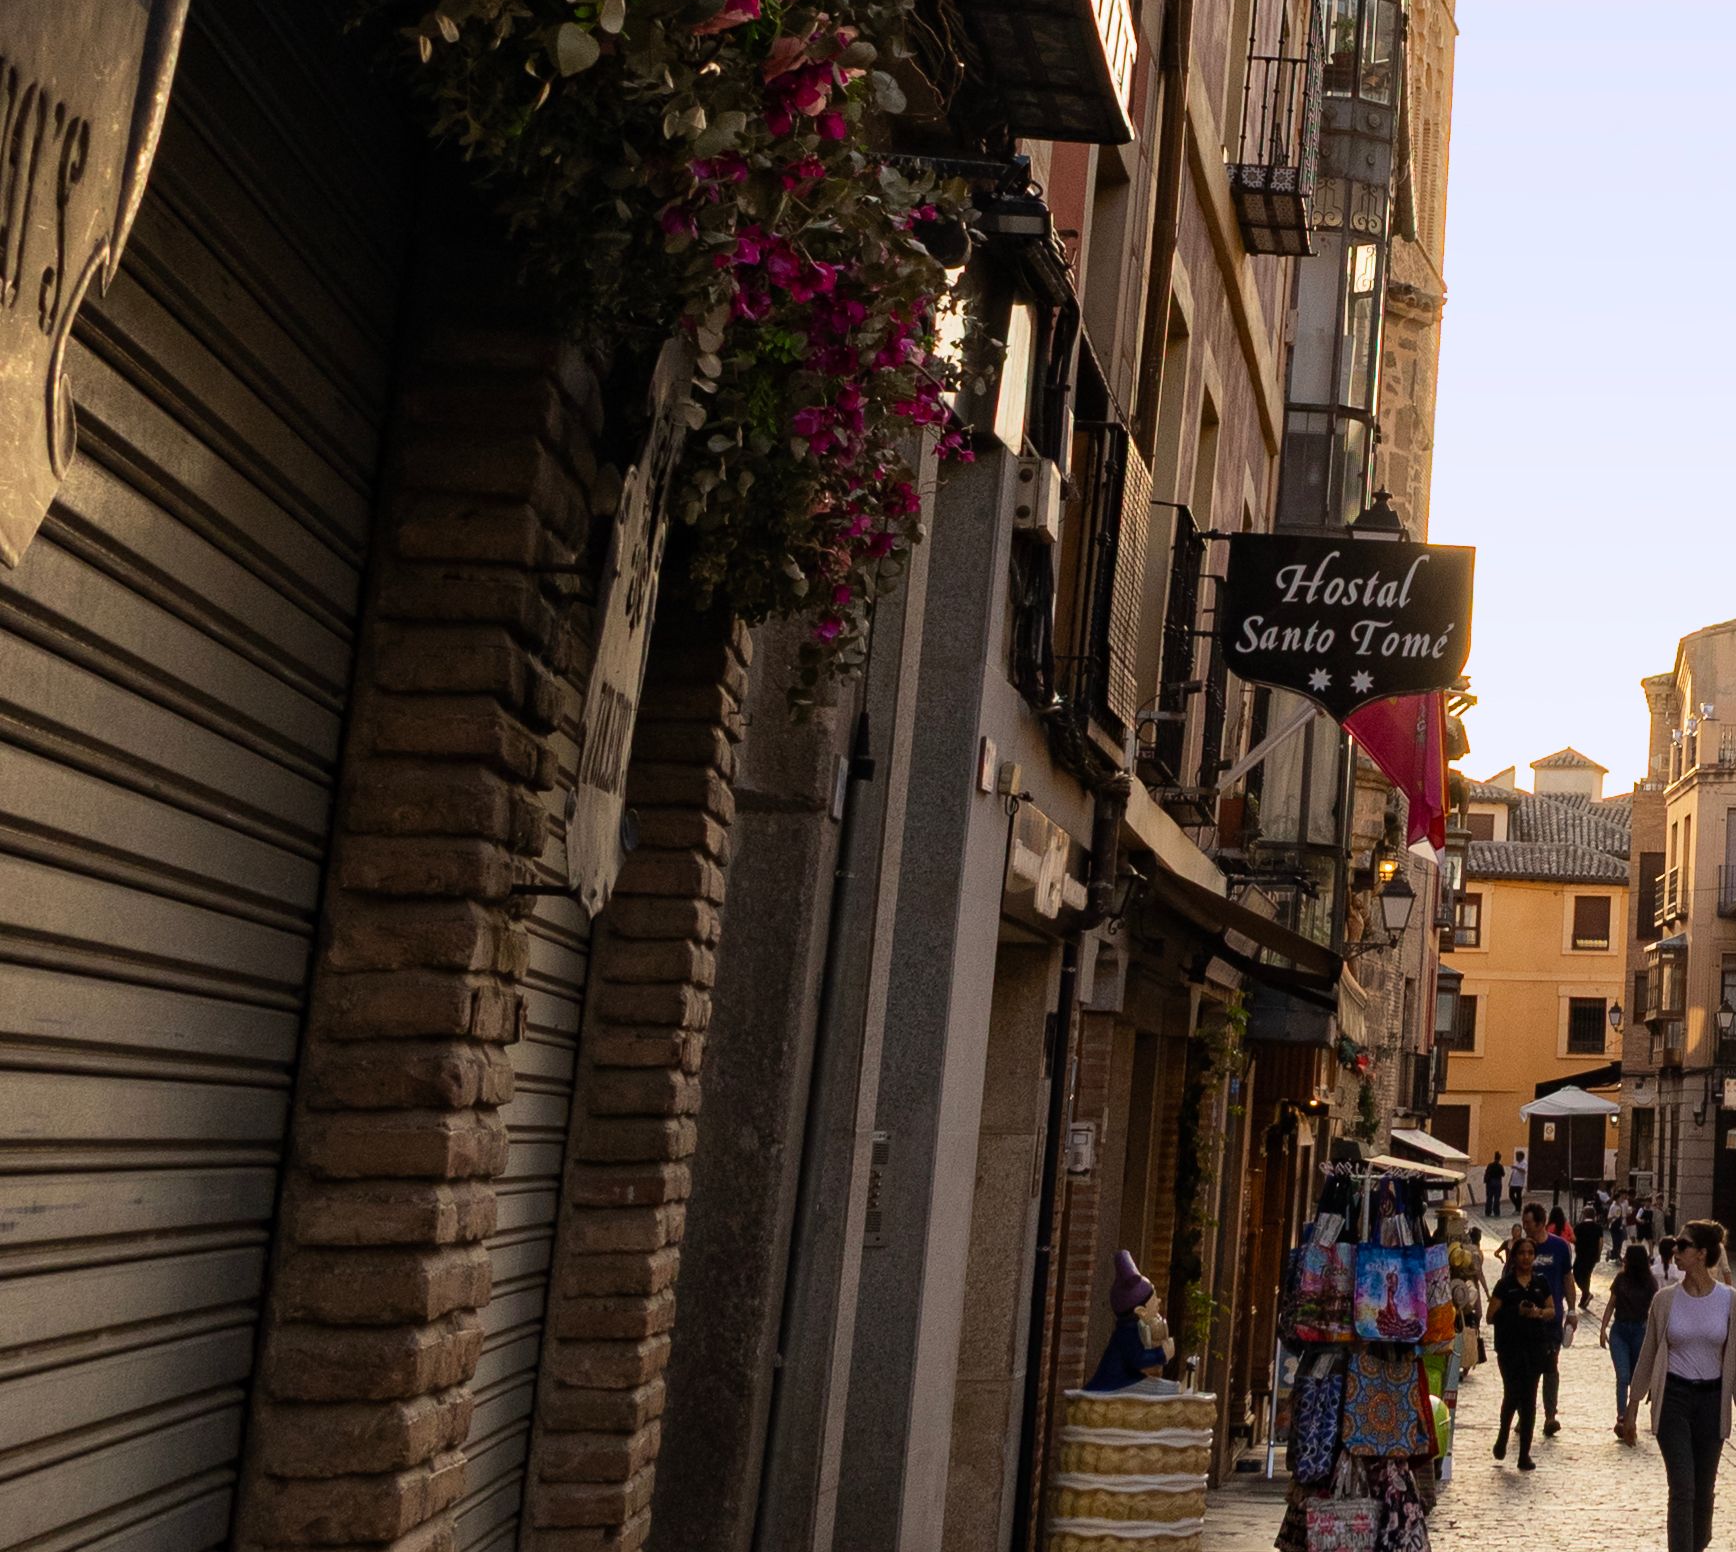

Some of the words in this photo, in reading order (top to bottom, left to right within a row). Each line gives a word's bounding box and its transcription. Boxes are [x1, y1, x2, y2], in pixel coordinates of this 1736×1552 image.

[1275, 550, 1430, 609] Hostal
[1235, 615, 1336, 654] Santo
[1350, 619, 1455, 659] Tomé
